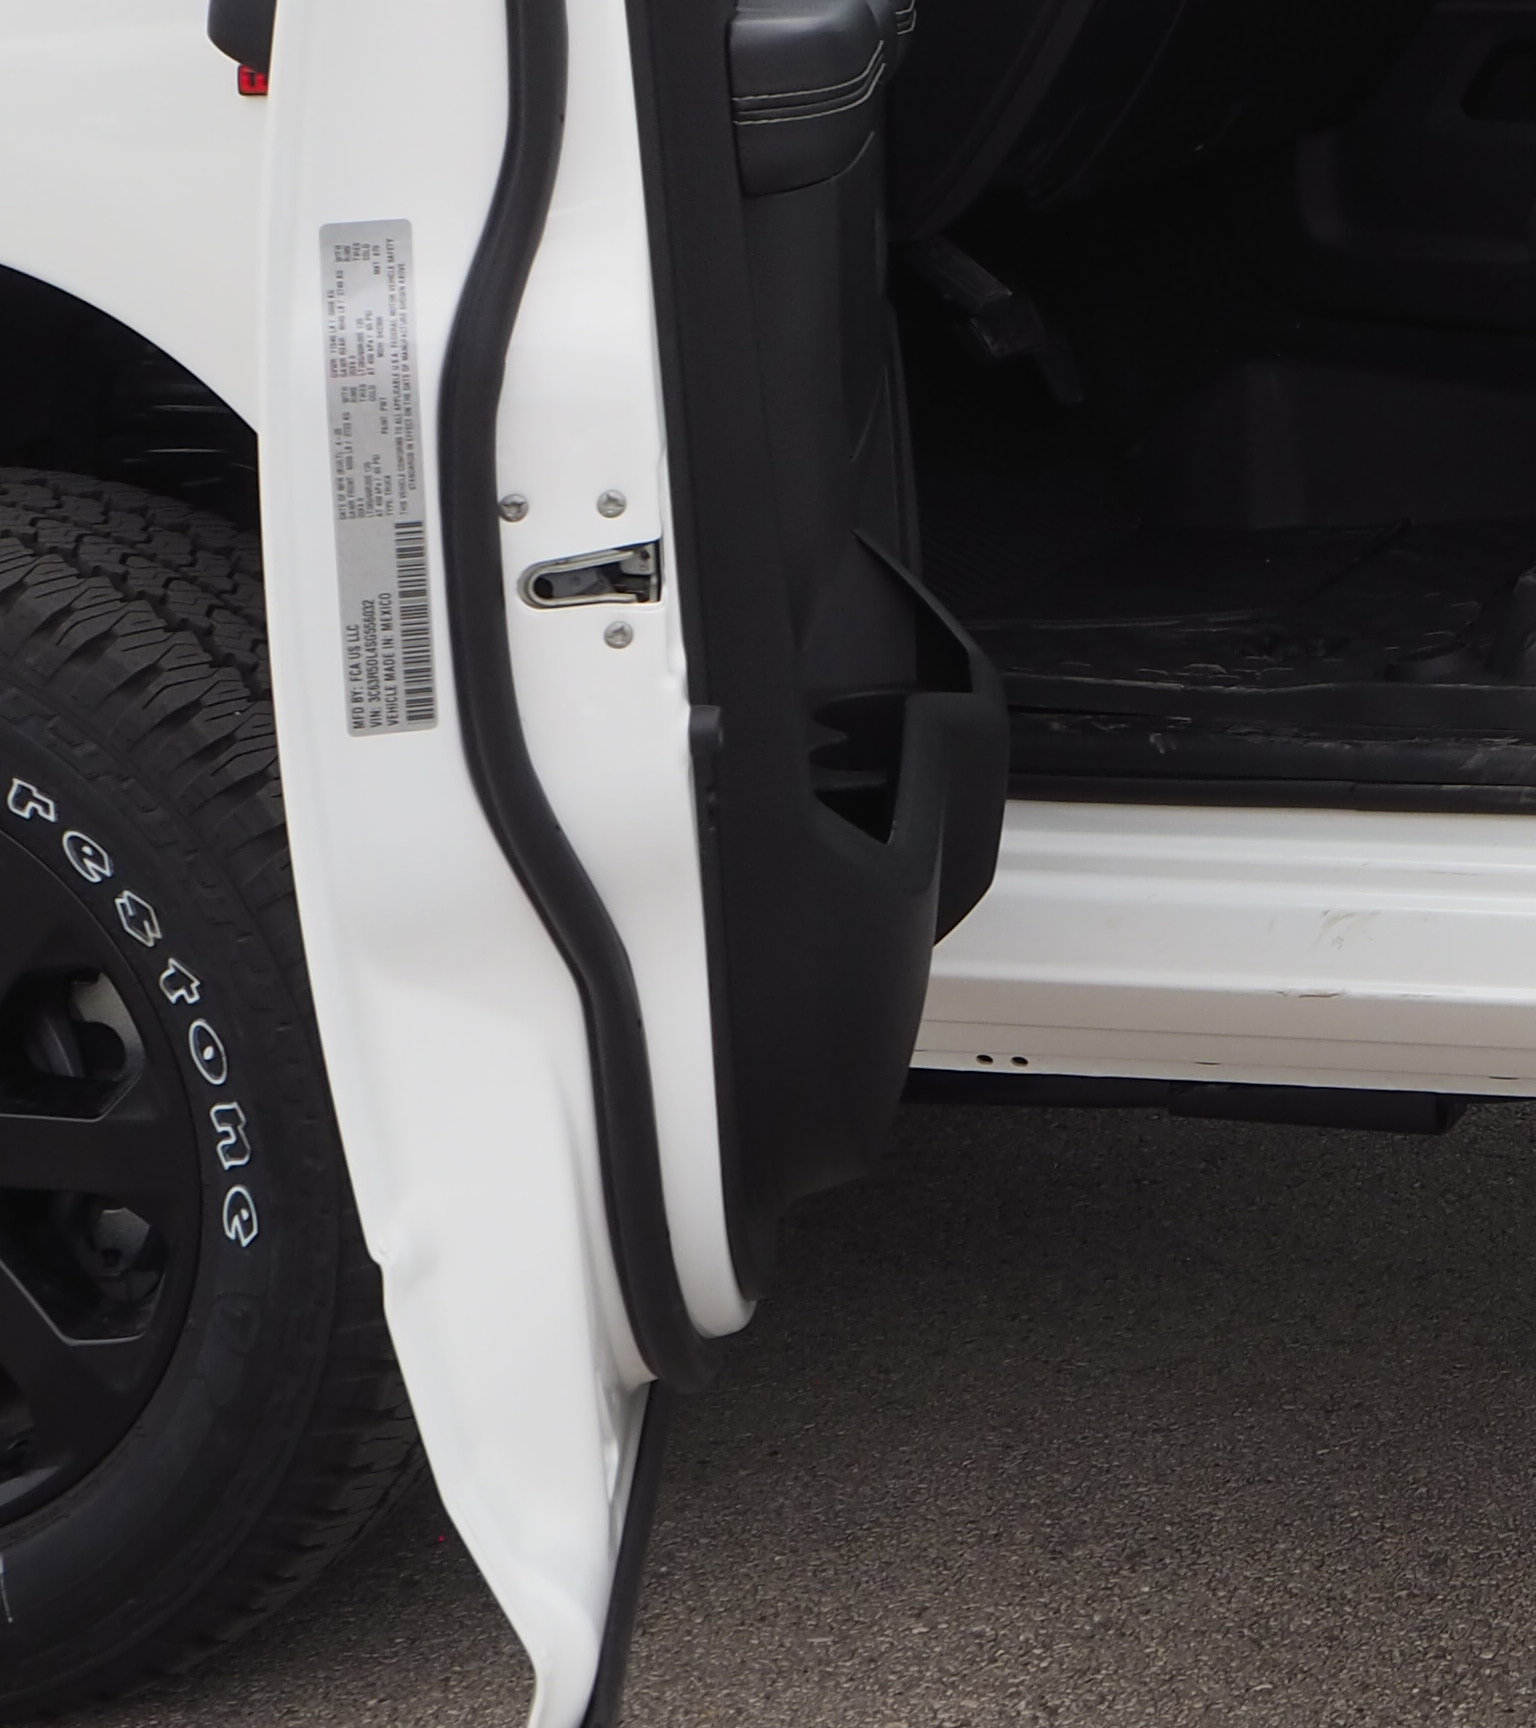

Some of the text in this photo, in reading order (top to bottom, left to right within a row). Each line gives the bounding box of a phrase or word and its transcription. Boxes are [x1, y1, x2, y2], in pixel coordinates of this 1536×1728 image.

[379, 592, 394, 631] MEXICO
[346, 624, 365, 729] MFD BY: FCA US LLC
[382, 653, 396, 681] MADE
[368, 707, 382, 727] VIN:
[384, 685, 399, 726] VEHICLE
